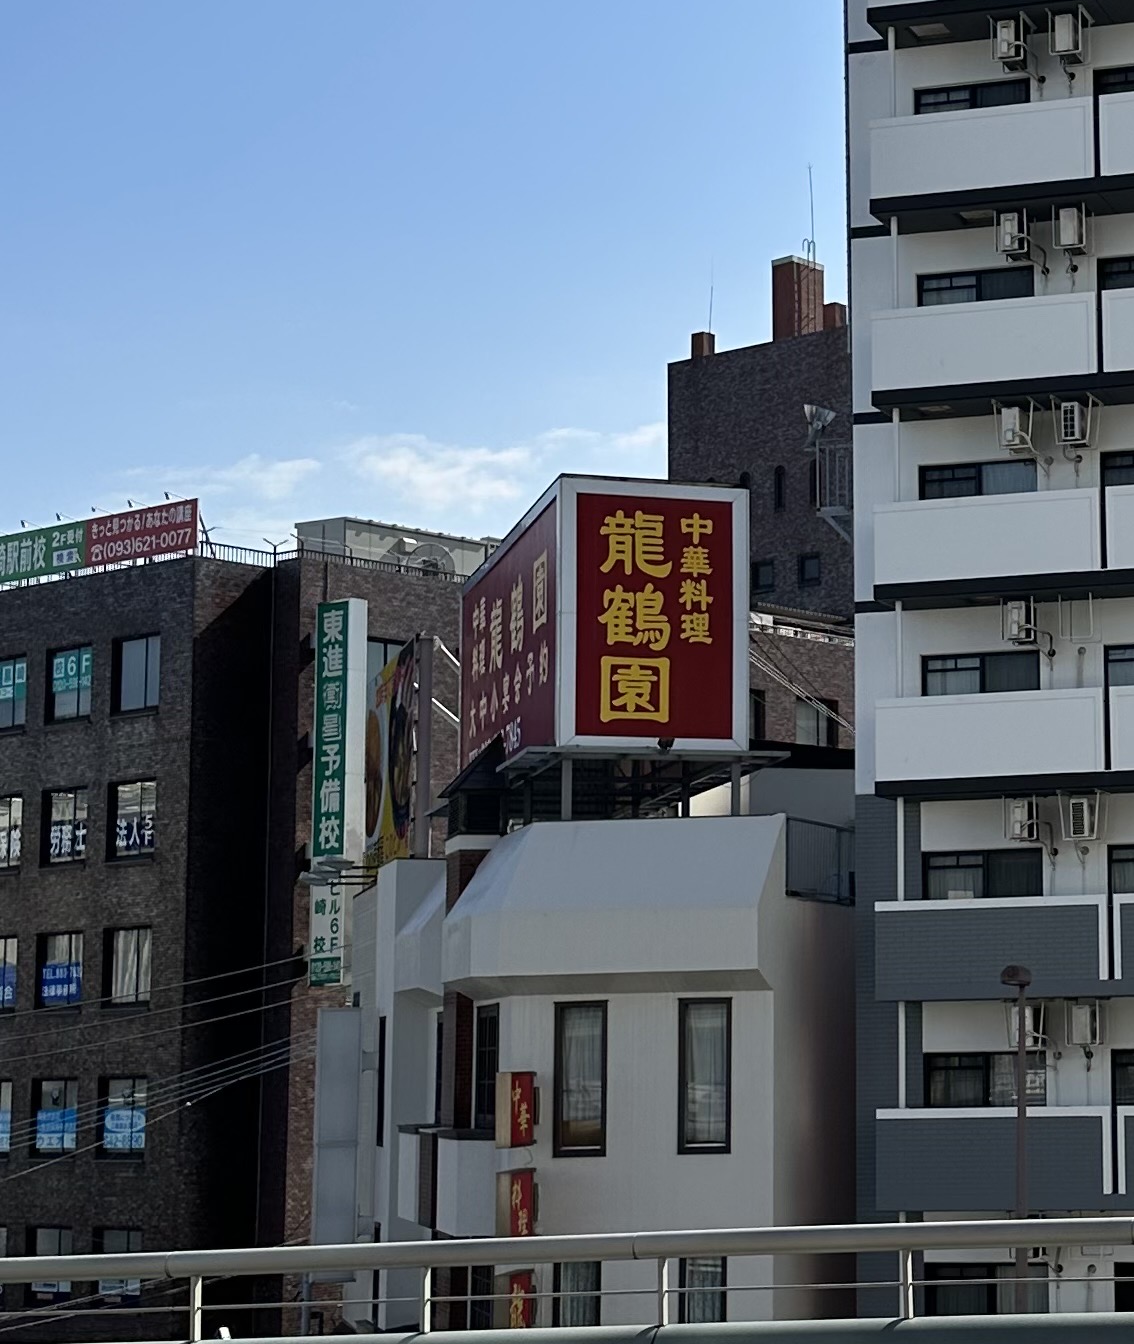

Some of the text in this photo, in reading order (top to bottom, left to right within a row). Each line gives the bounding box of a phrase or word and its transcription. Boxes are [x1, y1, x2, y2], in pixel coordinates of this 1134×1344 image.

[104, 528, 192, 560] (093)621-0077
[679, 513, 714, 645] 中華料理
[489, 548, 548, 674] 龍鶴園
[598, 510, 673, 723] 龍鶴園
[319, 609, 344, 850] 東進衛星予備校
[511, 1080, 530, 1137] 中華
